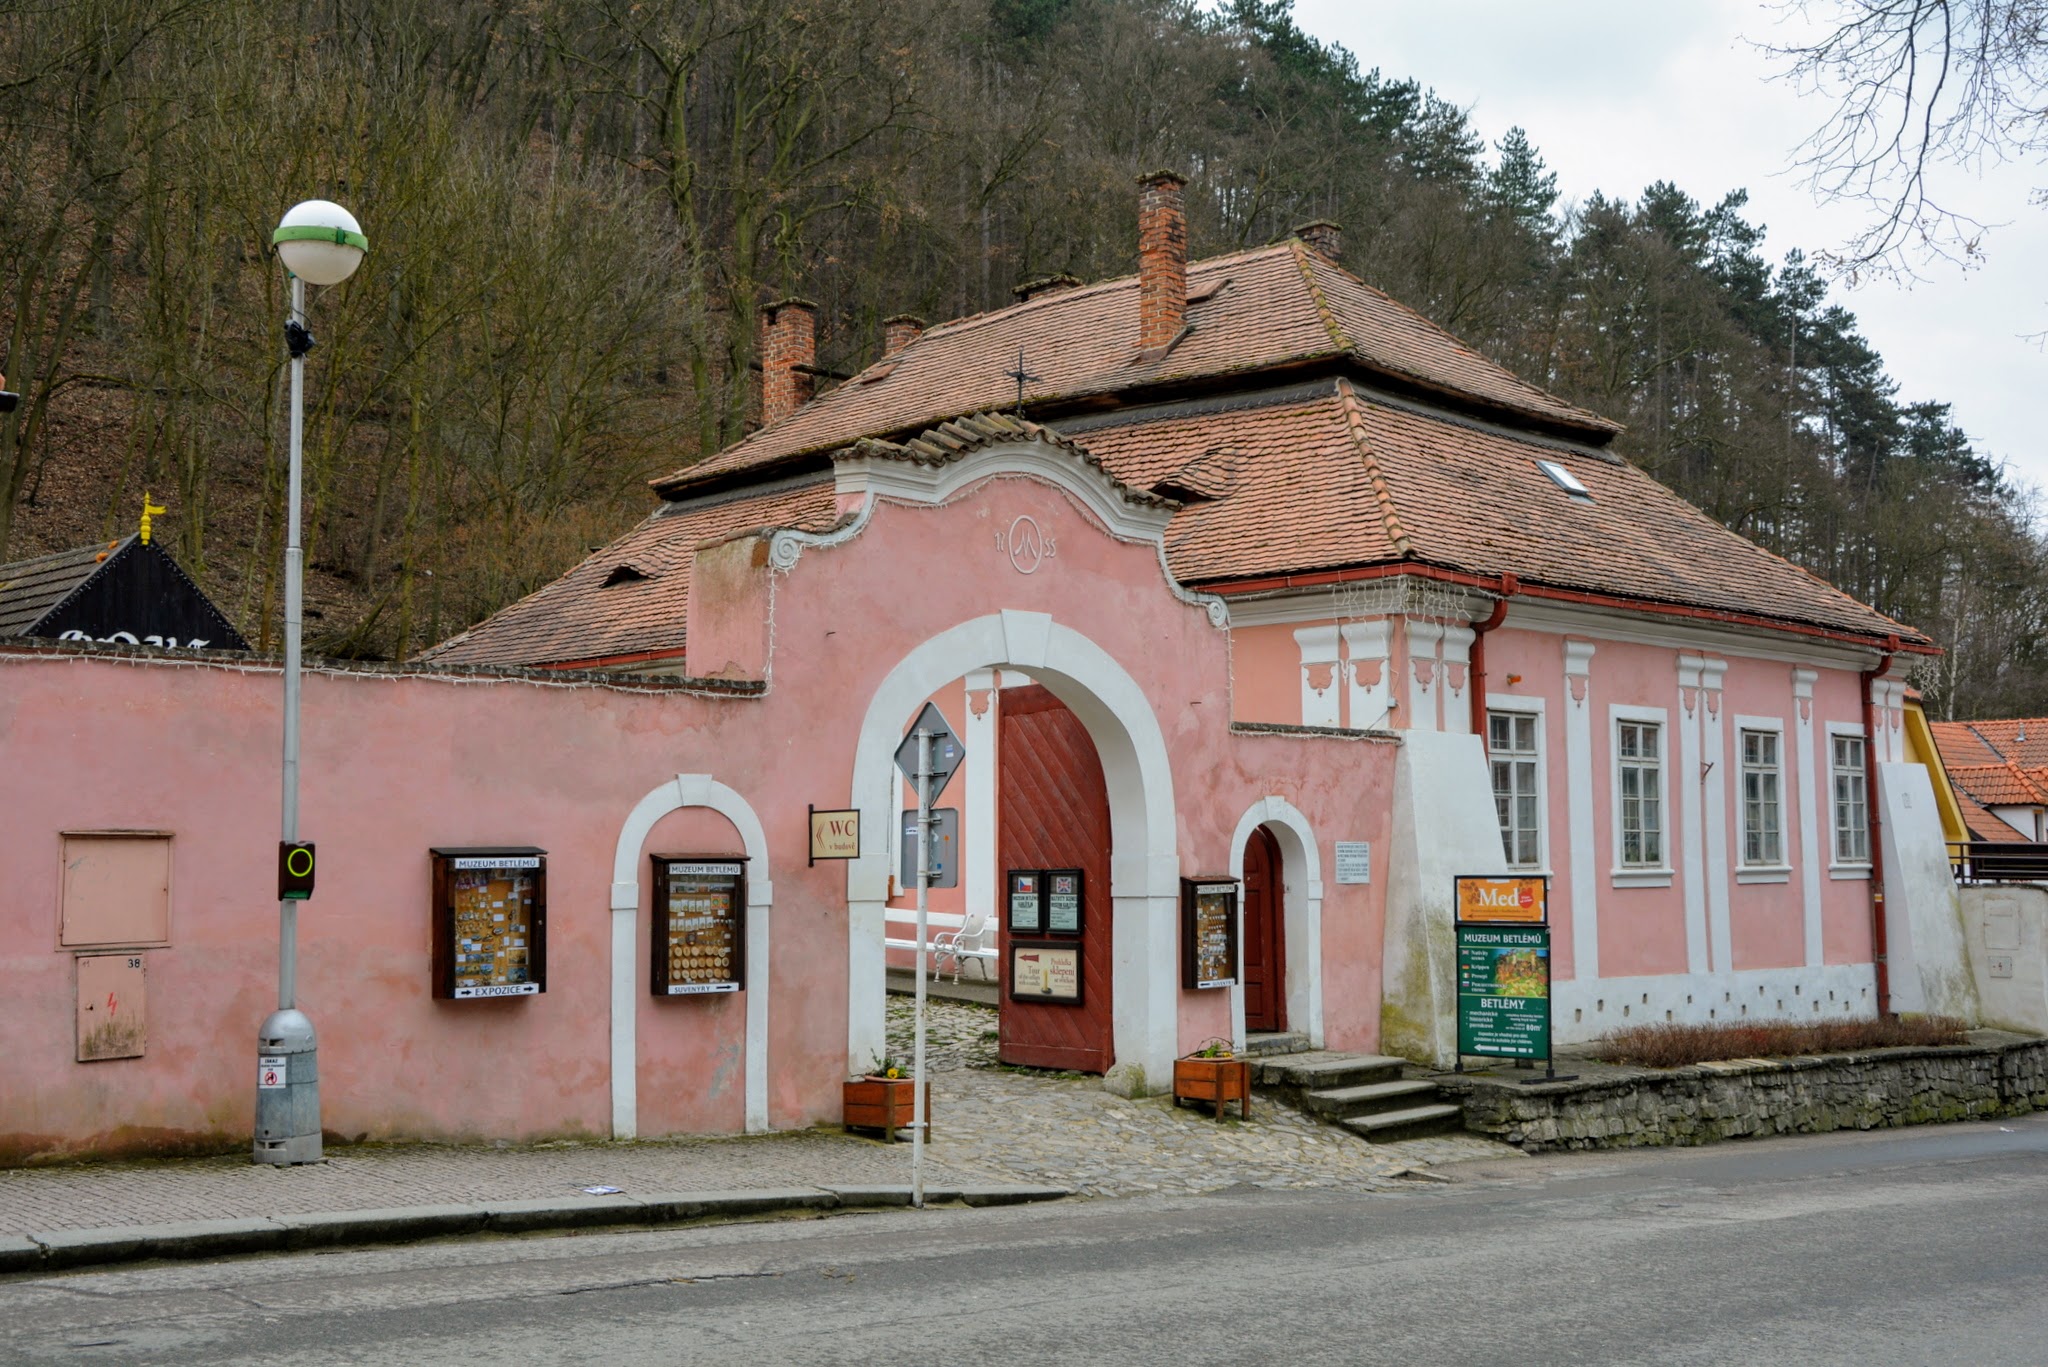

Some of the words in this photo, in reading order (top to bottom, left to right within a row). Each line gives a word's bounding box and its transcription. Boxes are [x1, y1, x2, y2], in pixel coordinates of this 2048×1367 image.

[829, 819, 856, 837] WC
[458, 860, 496, 868] MUZEUM
[498, 858, 537, 868] BETLÉMŮ
[671, 865, 704, 873] MUZEUM
[705, 864, 739, 874] BETLÉMŮ
[1478, 887, 1520, 907] Med
[1464, 933, 1500, 943] MUZEUM
[1502, 932, 1542, 944] BETLÉMŮ
[127, 958, 141, 969] 38
[474, 985, 521, 996] EXPOZICE
[1480, 997, 1526, 1010] BETLÉMY
